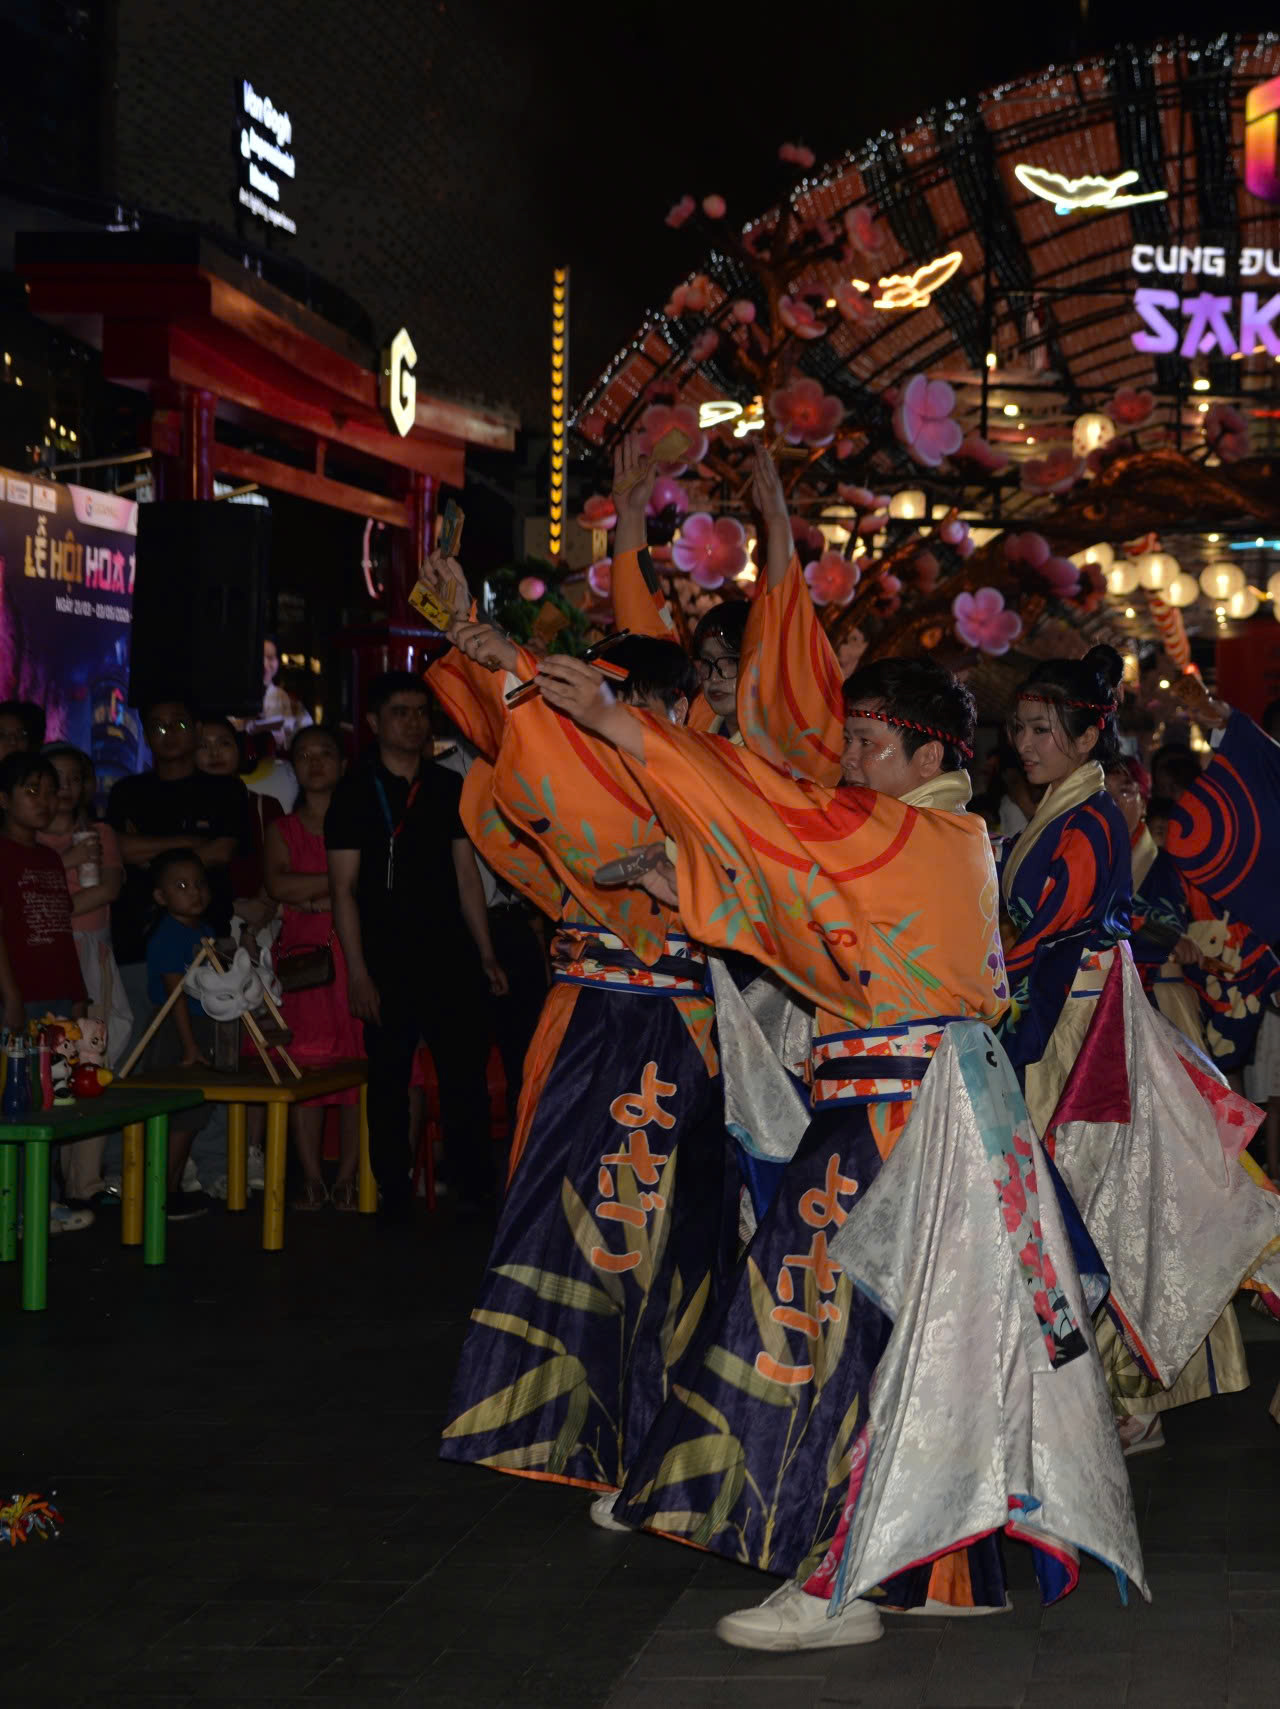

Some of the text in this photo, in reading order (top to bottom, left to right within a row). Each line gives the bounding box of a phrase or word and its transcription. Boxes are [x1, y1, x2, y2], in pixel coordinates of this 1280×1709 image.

[1131, 244, 1225, 277] CUNG
[390, 327, 417, 438] G
[24, 514, 48, 579] LỄ
[50, 529, 83, 593] HỘI
[85, 544, 125, 594] HOA
